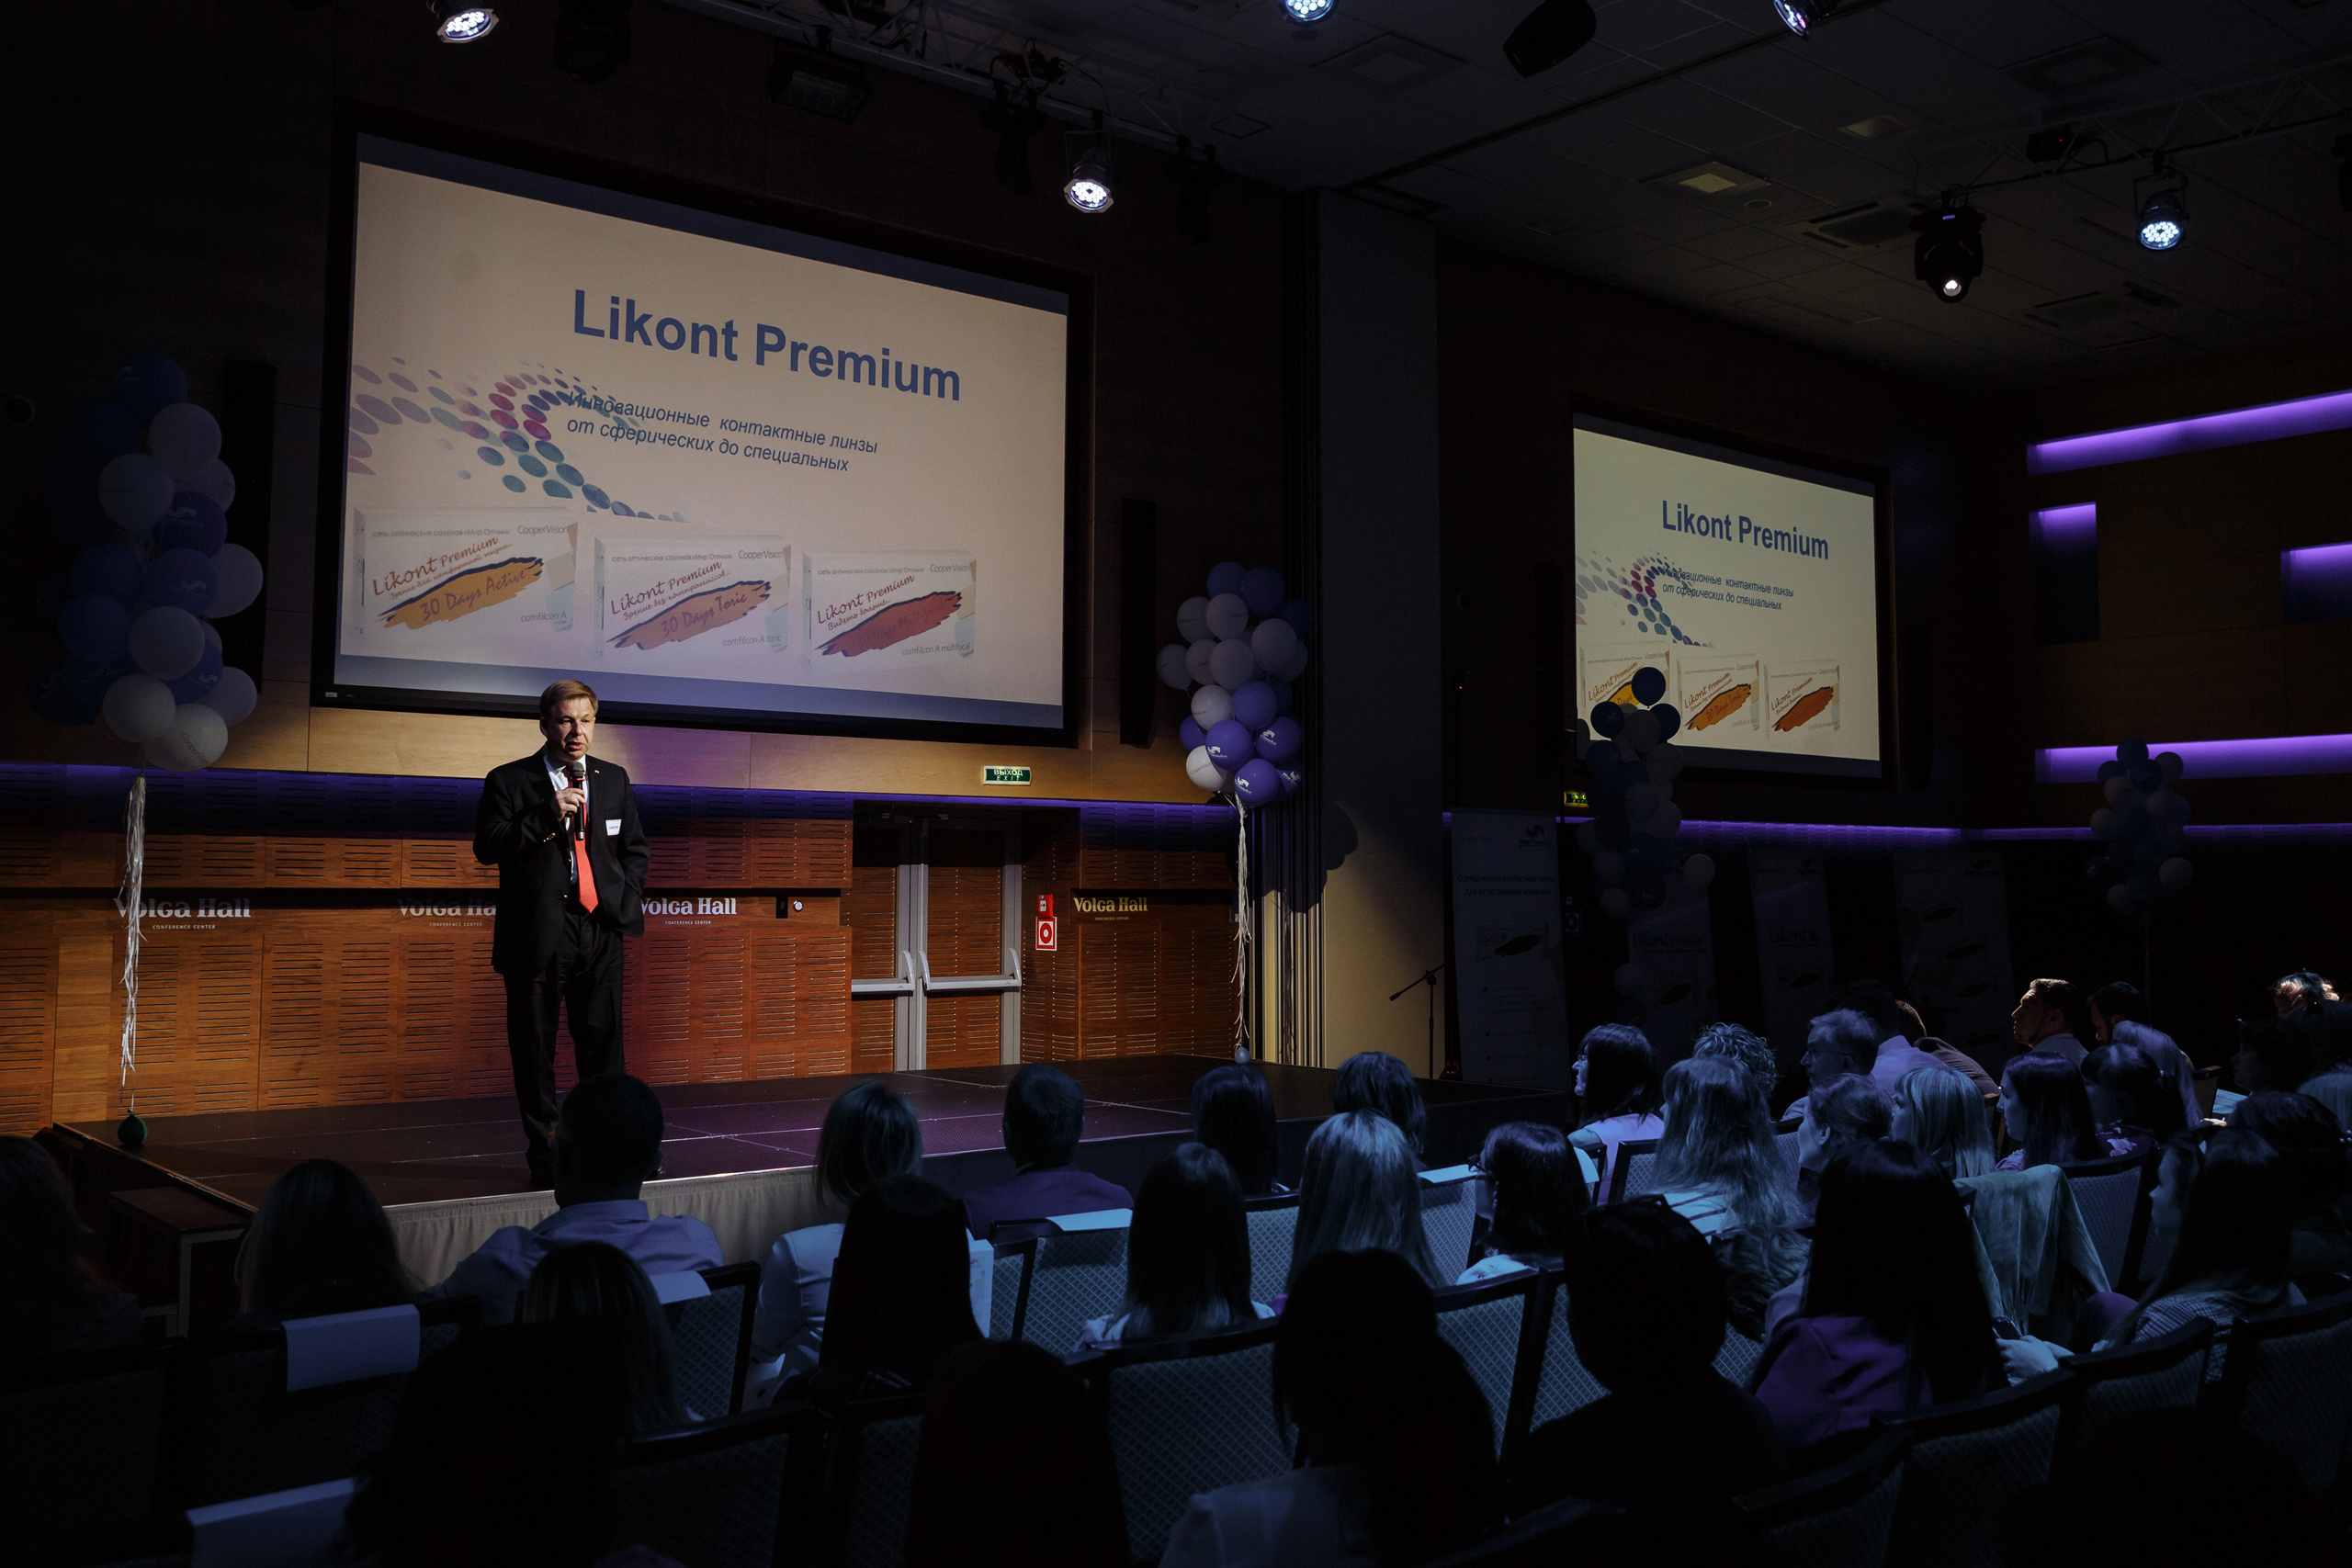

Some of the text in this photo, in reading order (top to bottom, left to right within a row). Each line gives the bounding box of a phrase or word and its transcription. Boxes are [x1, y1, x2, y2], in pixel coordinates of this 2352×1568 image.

[573, 289, 961, 401] Likont Premium
[568, 390, 879, 455] Инновационные контактные линзы
[567, 418, 850, 472] от сферических до специальных
[517, 525, 569, 536] CooperVision
[1662, 500, 1829, 560] Likont Premium
[372, 537, 499, 596] Likont Premium
[738, 549, 785, 560] CooperVision
[929, 563, 971, 574] CooperVision
[420, 568, 526, 622] 30 Days Active
[610, 561, 722, 615] Likont Premium
[817, 574, 915, 625] Likont Premium
[1662, 583, 1782, 610] от сферических до специальных
[1725, 579, 1772, 593] контактные
[1772, 585, 1794, 598] линзы
[660, 592, 748, 638] 30 Days Toric
[1588, 674, 1615, 702] Likont
[1684, 685, 1707, 710] Likont
[1770, 690, 1792, 712] Likont
[993, 769, 1023, 777] ВЫХОД
[197, 897, 252, 919] Hall
[466, 897, 497, 917] Ha
[697, 897, 738, 916] Hall
[1117, 897, 1148, 913] Hall
